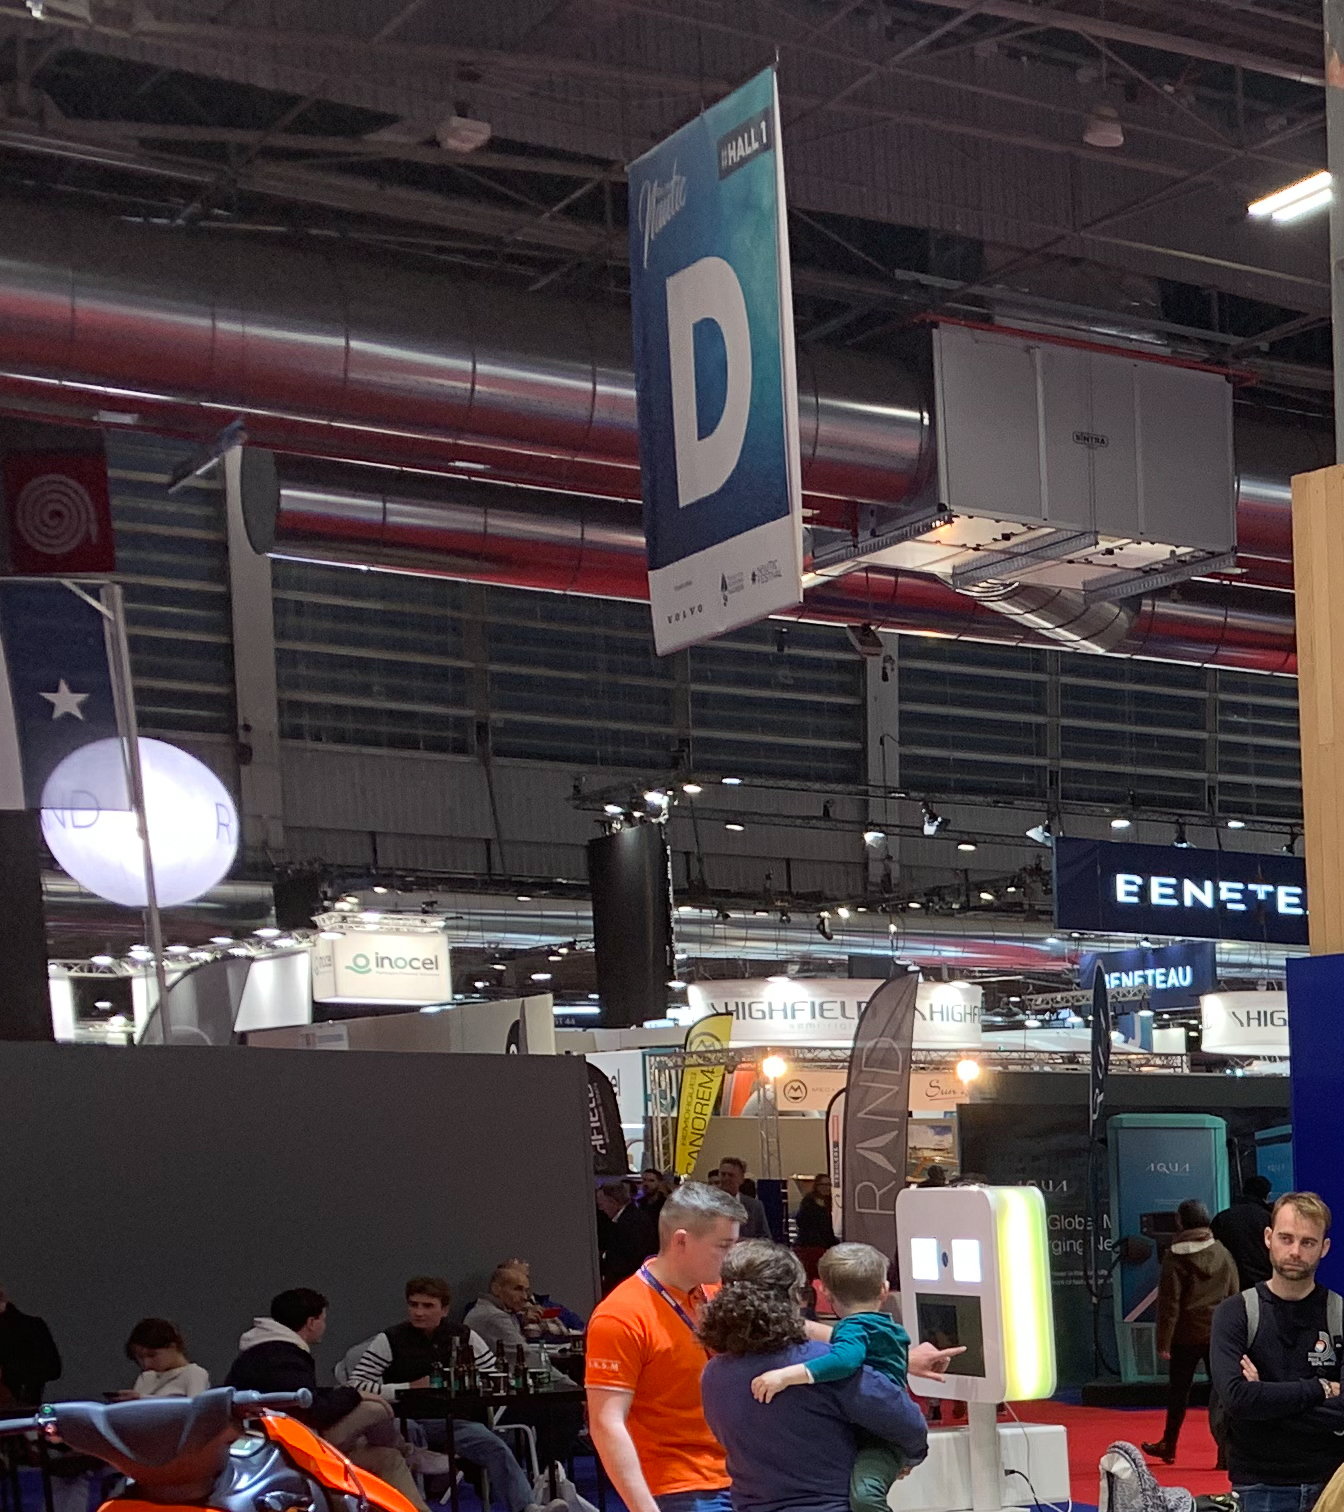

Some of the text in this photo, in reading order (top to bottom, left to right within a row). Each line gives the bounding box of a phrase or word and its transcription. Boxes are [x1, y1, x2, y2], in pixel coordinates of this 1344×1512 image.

[721, 119, 767, 170] #HALL 1
[665, 256, 753, 509] D
[667, 603, 703, 624] VOLVO
[375, 951, 439, 971] inocel
[855, 1037, 903, 1215] RAND
